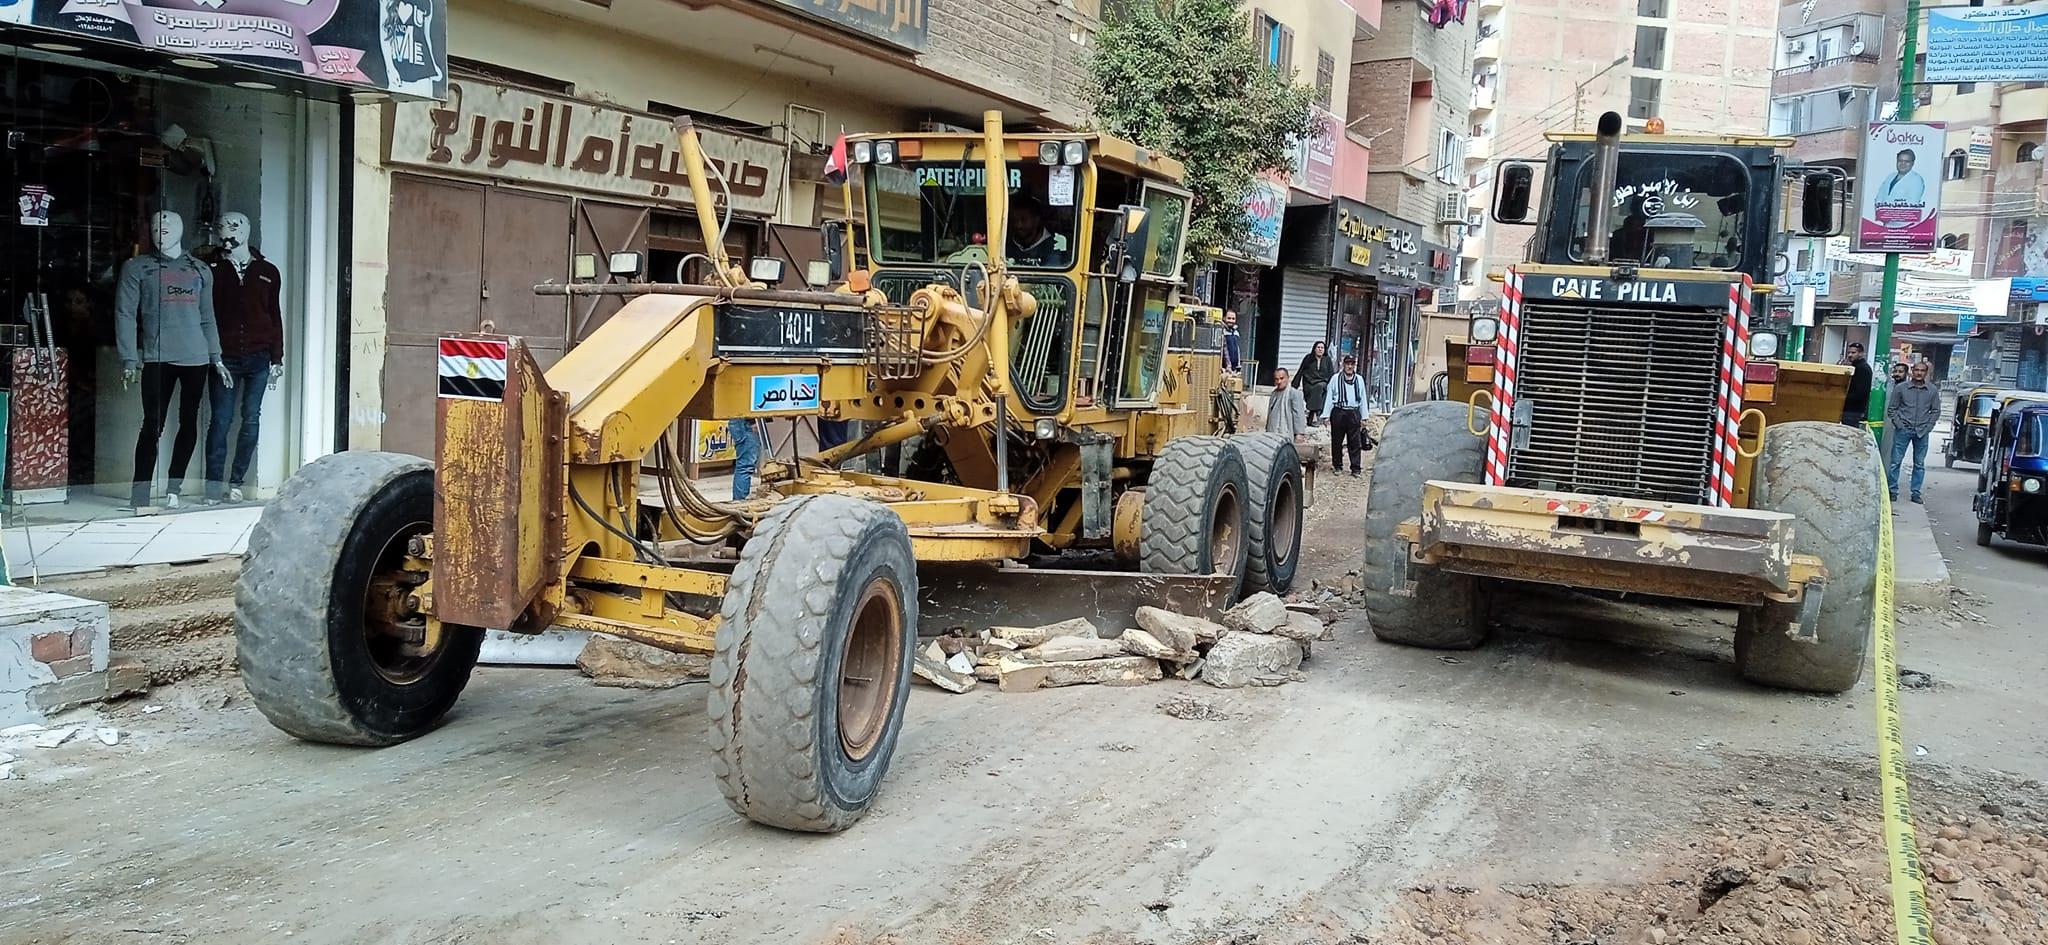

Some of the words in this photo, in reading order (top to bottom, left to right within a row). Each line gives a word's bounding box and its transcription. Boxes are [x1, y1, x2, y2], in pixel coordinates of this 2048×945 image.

[153, 9, 224, 32] الجاهزة
[461, 100, 573, 168] النور
[778, 311, 801, 345] 140
[757, 388, 787, 409] مصر
[789, 379, 817, 406] تحيا
